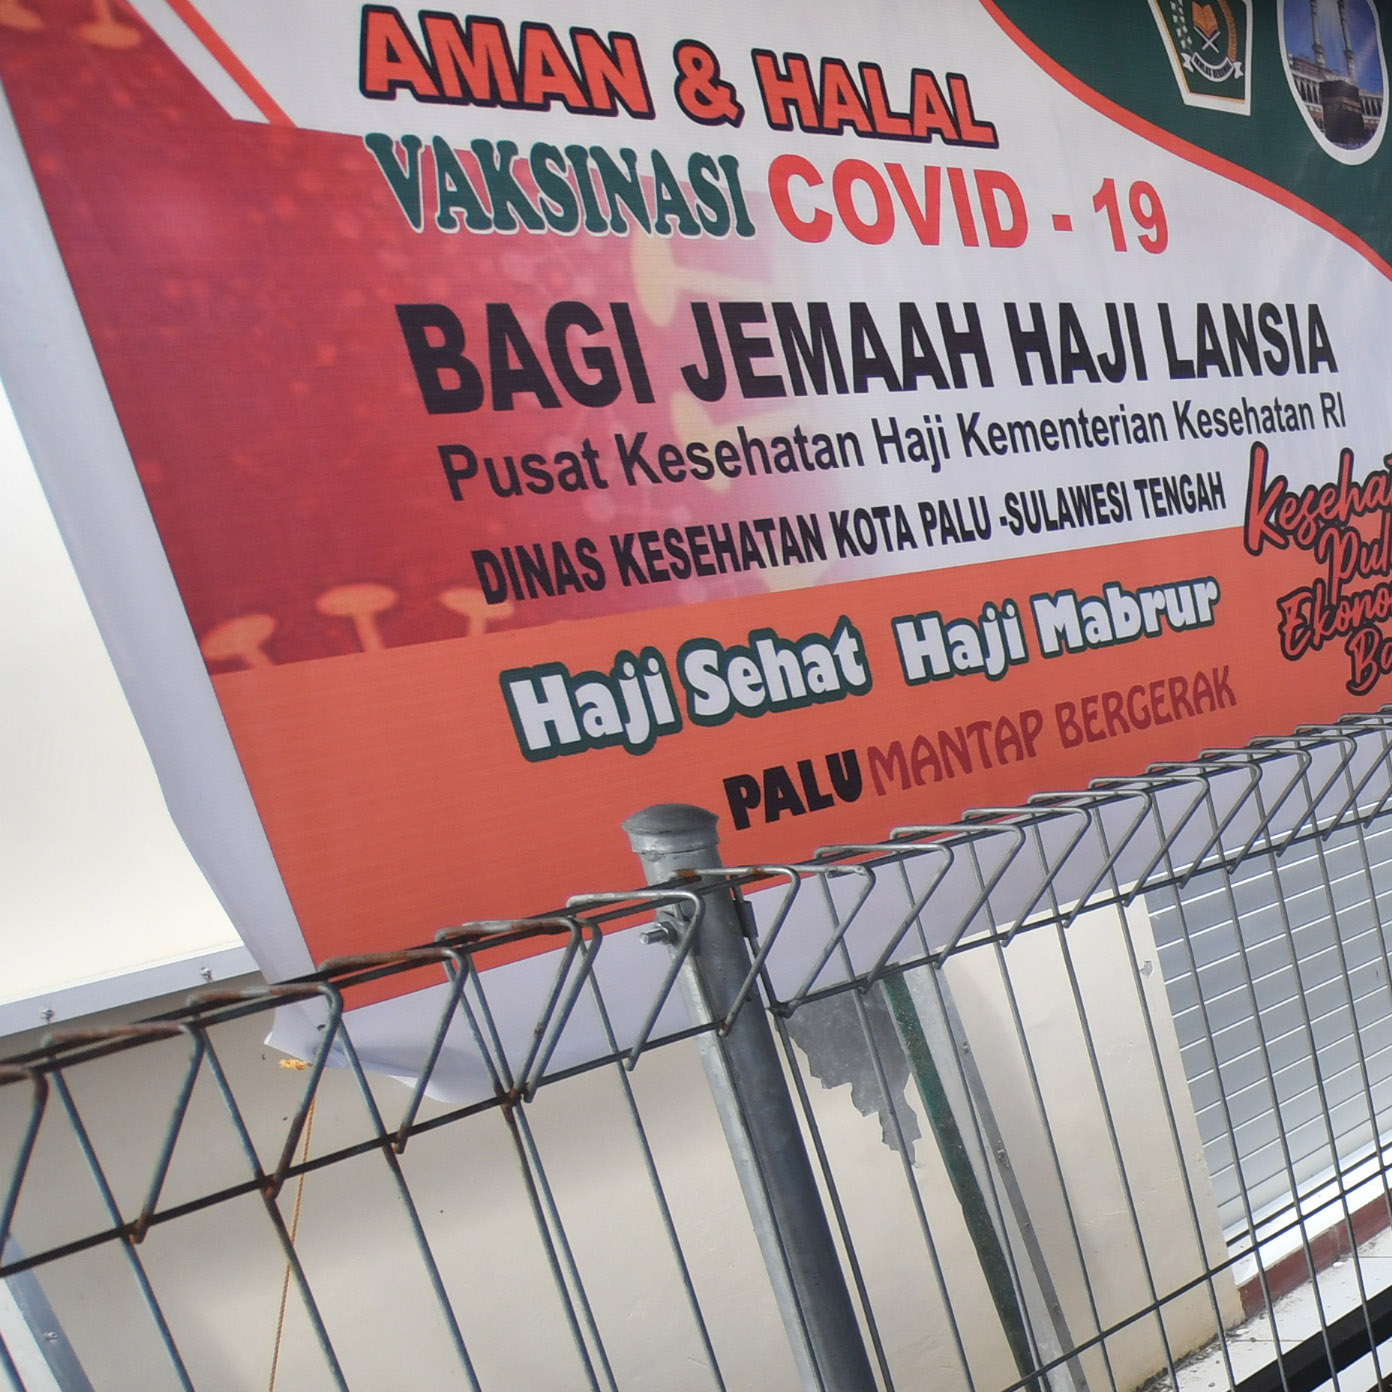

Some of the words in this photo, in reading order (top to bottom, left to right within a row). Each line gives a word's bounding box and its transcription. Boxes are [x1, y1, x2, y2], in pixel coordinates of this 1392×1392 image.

[360, 5, 656, 120] AMAN
[674, 39, 744, 129] &
[752, 49, 999, 149] HALAL
[364, 132, 756, 239] VAKSINASI
[767, 154, 1028, 249] COVID
[1092, 177, 1168, 255] 19
[395, 300, 656, 415] BAGI
[681, 301, 994, 402] JEMAAH
[1004, 302, 1148, 388] HAJI
[1158, 302, 1338, 380] LANSIA
[439, 437, 608, 501] Pusat
[616, 423, 864, 486] Kesehatan
[872, 415, 948, 472] Haji
[957, 405, 1166, 458] Kementerian
[1173, 396, 1316, 440] Kesehatan
[1320, 391, 1346, 429] RI
[472, 536, 606, 605] DINAS
[610, 513, 828, 587] KESEHATAN
[829, 504, 925, 558] KOTA
[918, 496, 991, 549] PALU
[1134, 471, 1227, 514] TENGAH
[503, 648, 681, 760] Haji
[680, 616, 872, 726] Sehat
[892, 600, 1028, 684] Haji
[1030, 577, 1220, 659] Mabrur
[723, 749, 863, 831] PALU
[867, 708, 1045, 796] MANTAP
[1054, 665, 1238, 749] BERGERAK
